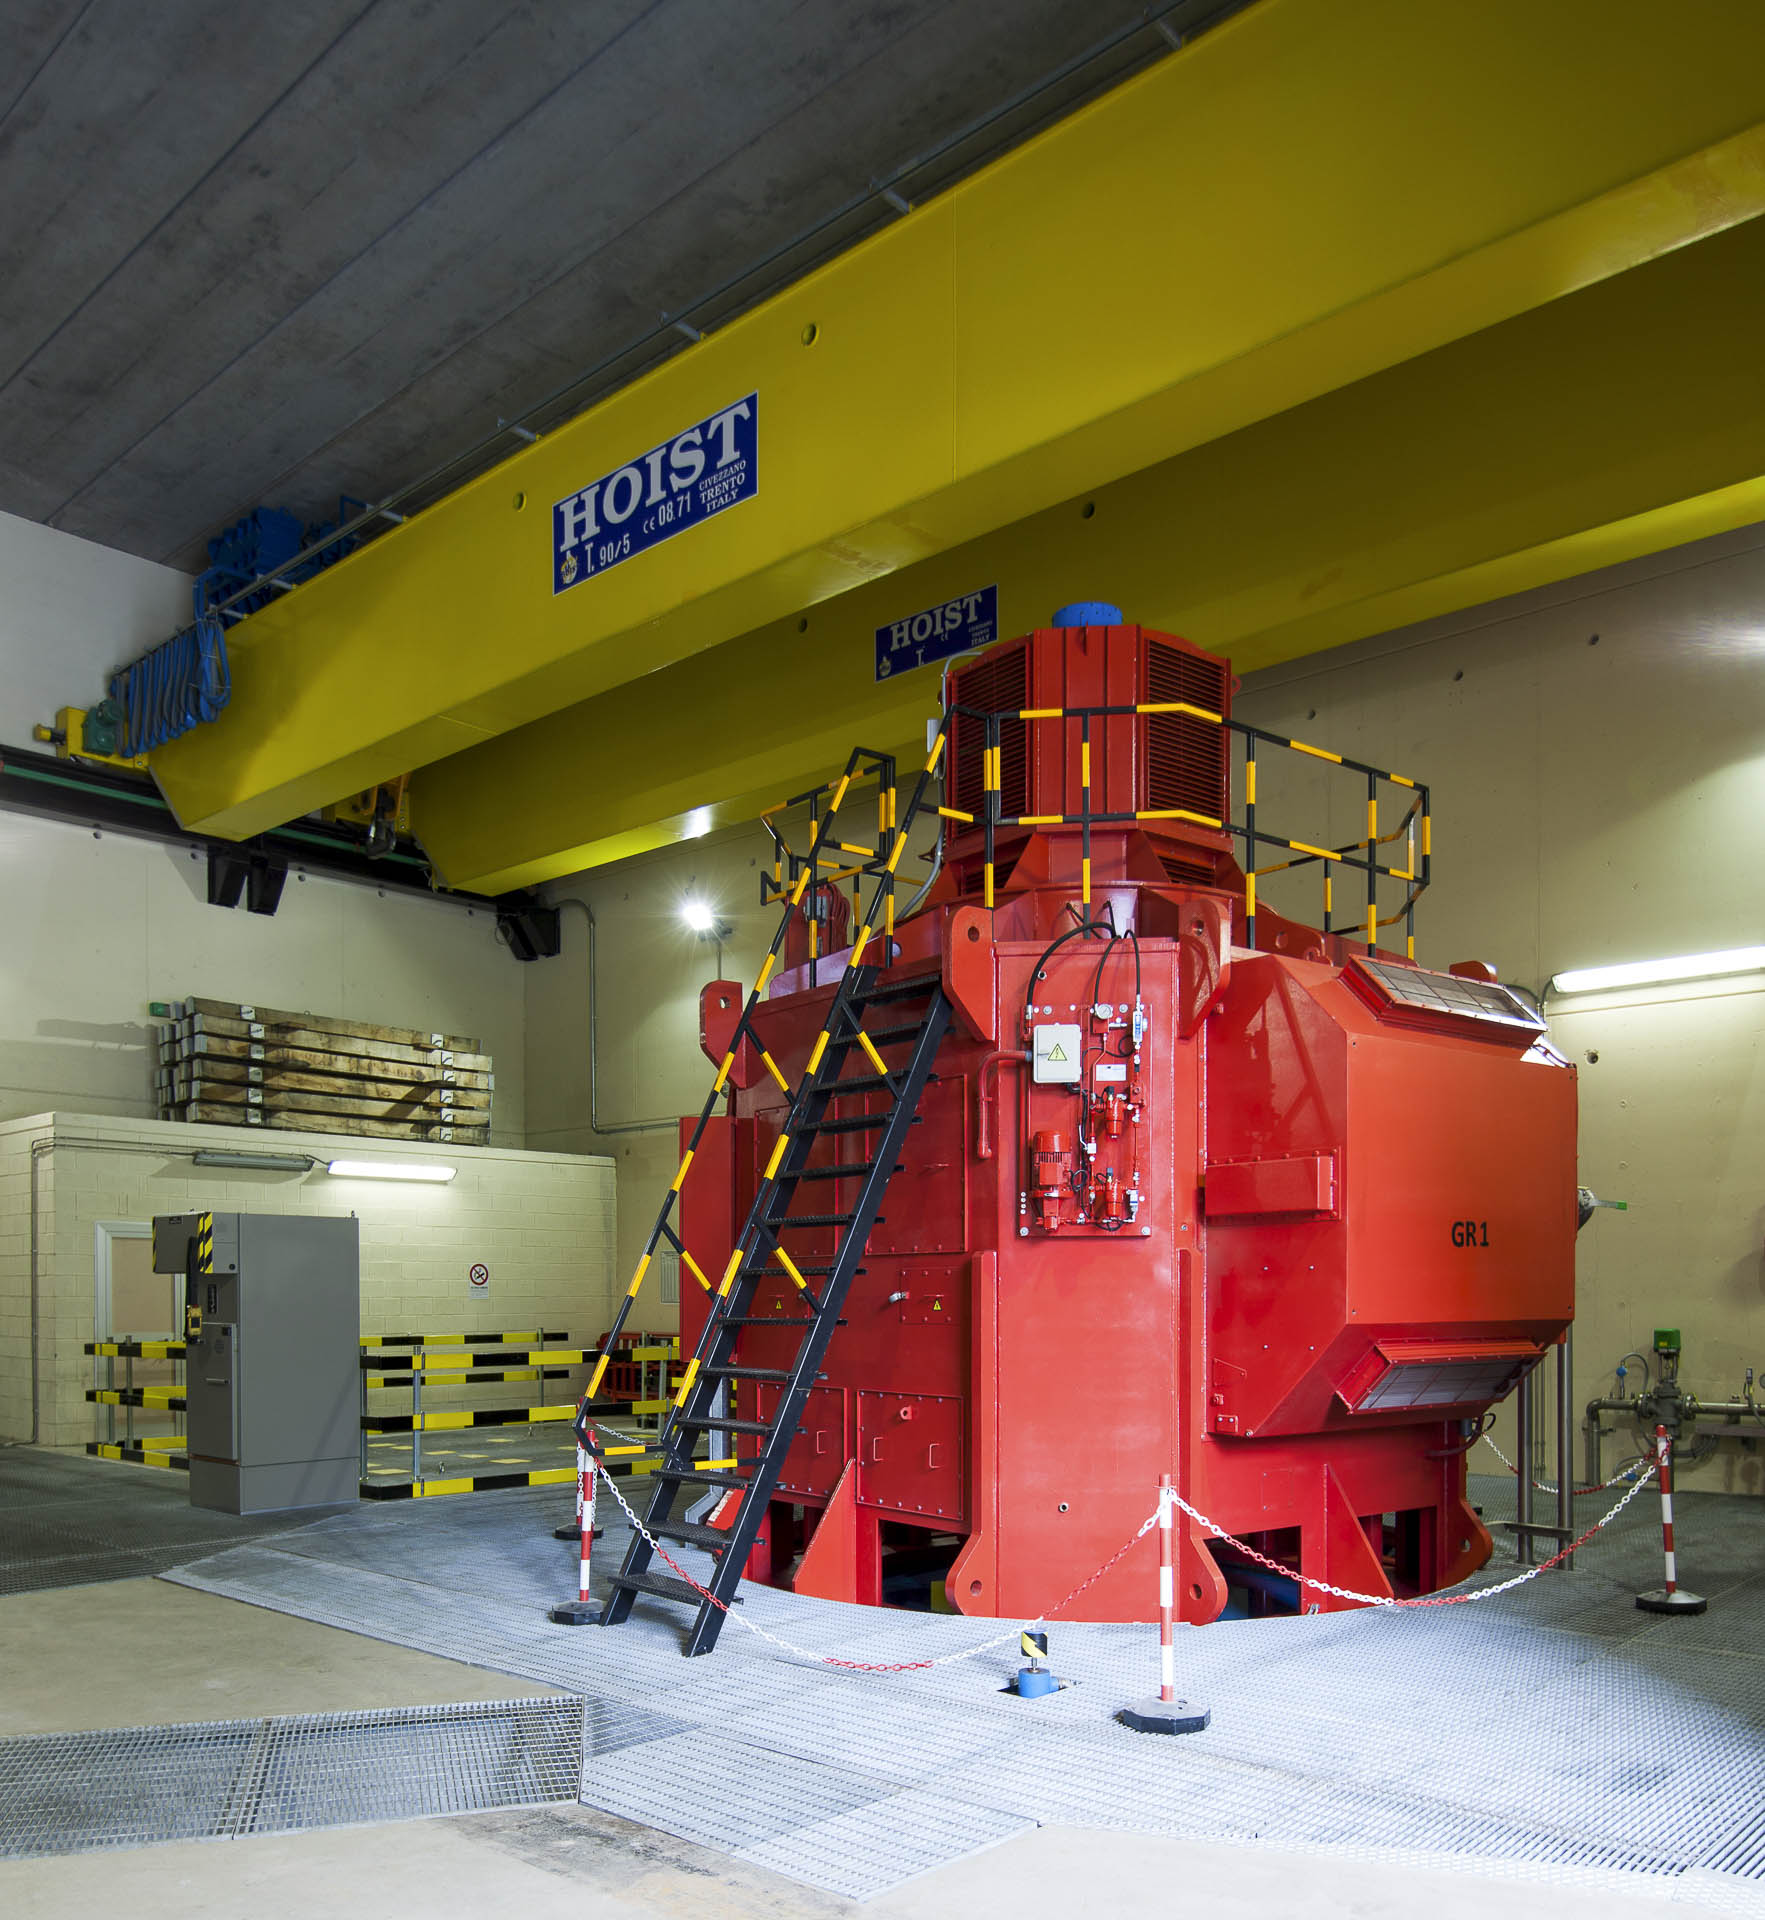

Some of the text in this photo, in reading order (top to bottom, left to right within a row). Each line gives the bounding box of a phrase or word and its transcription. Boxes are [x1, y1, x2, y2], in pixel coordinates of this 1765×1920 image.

[559, 401, 751, 552] HOIST
[699, 459, 746, 491] CIVEZZANO
[700, 473, 745, 505] TRENTO
[706, 489, 738, 513] ITALY
[600, 533, 631, 567] 90/5
[889, 592, 983, 652] HOIST
[1451, 1220, 1489, 1248] GR1
